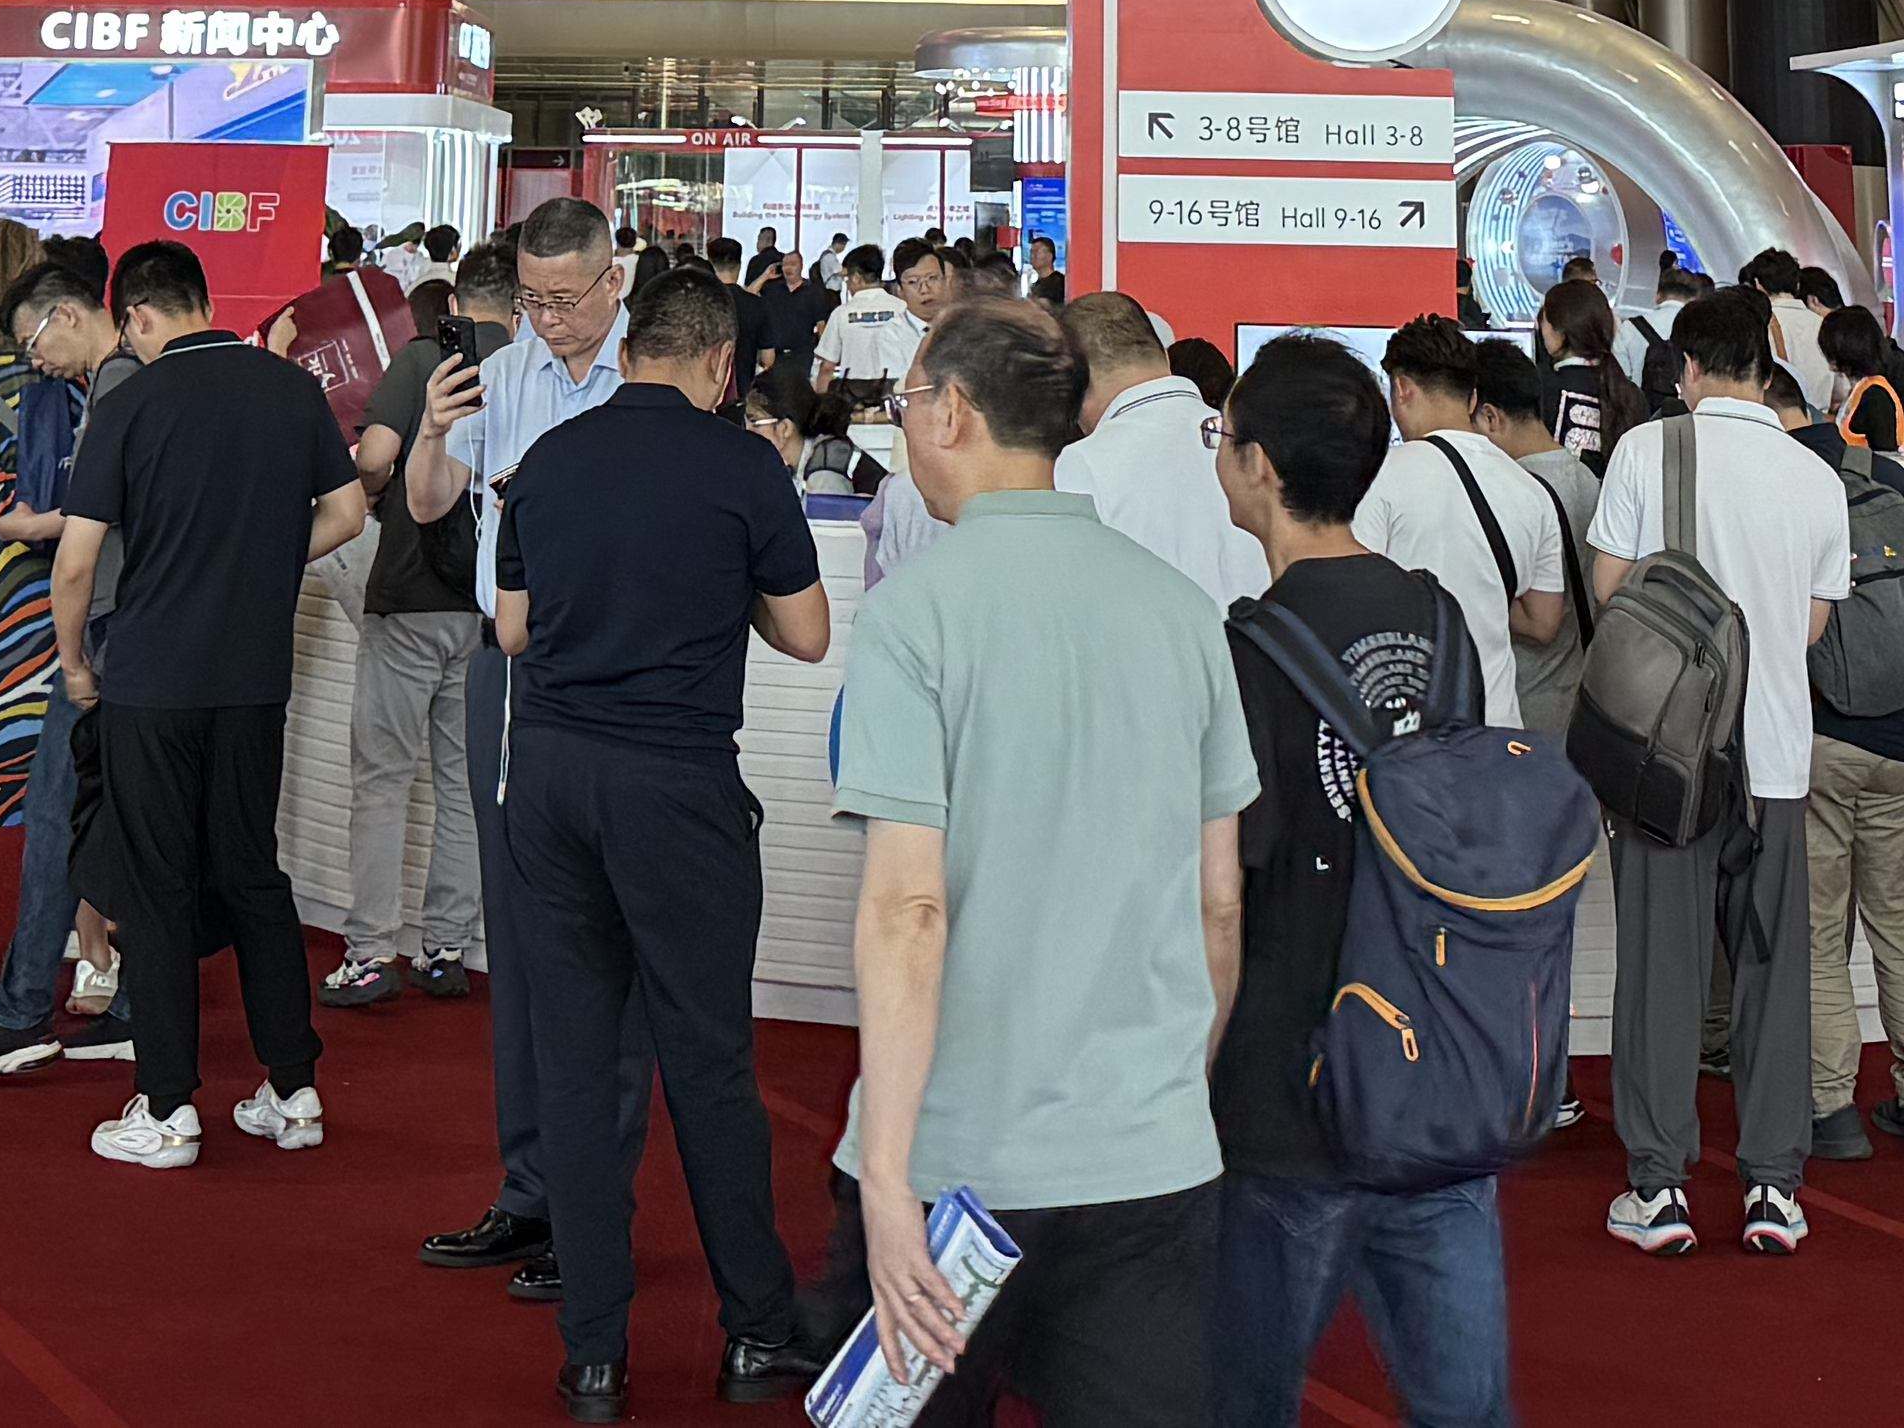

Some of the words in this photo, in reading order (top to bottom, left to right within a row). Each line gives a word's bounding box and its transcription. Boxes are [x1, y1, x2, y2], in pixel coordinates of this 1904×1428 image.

[41, 11, 150, 50] CIBF
[160, 10, 340, 56] 新闻中心
[691, 132, 717, 146] ON
[722, 132, 752, 146] AIR
[1199, 114, 1301, 145] 3-8号馆
[1325, 123, 1376, 146] Hall
[1386, 125, 1423, 147] 3-8
[164, 191, 280, 232] CIBF
[1149, 198, 1260, 228] 9-16号馆
[1282, 206, 1325, 230] Hall
[1334, 208, 1382, 231] 9-16
